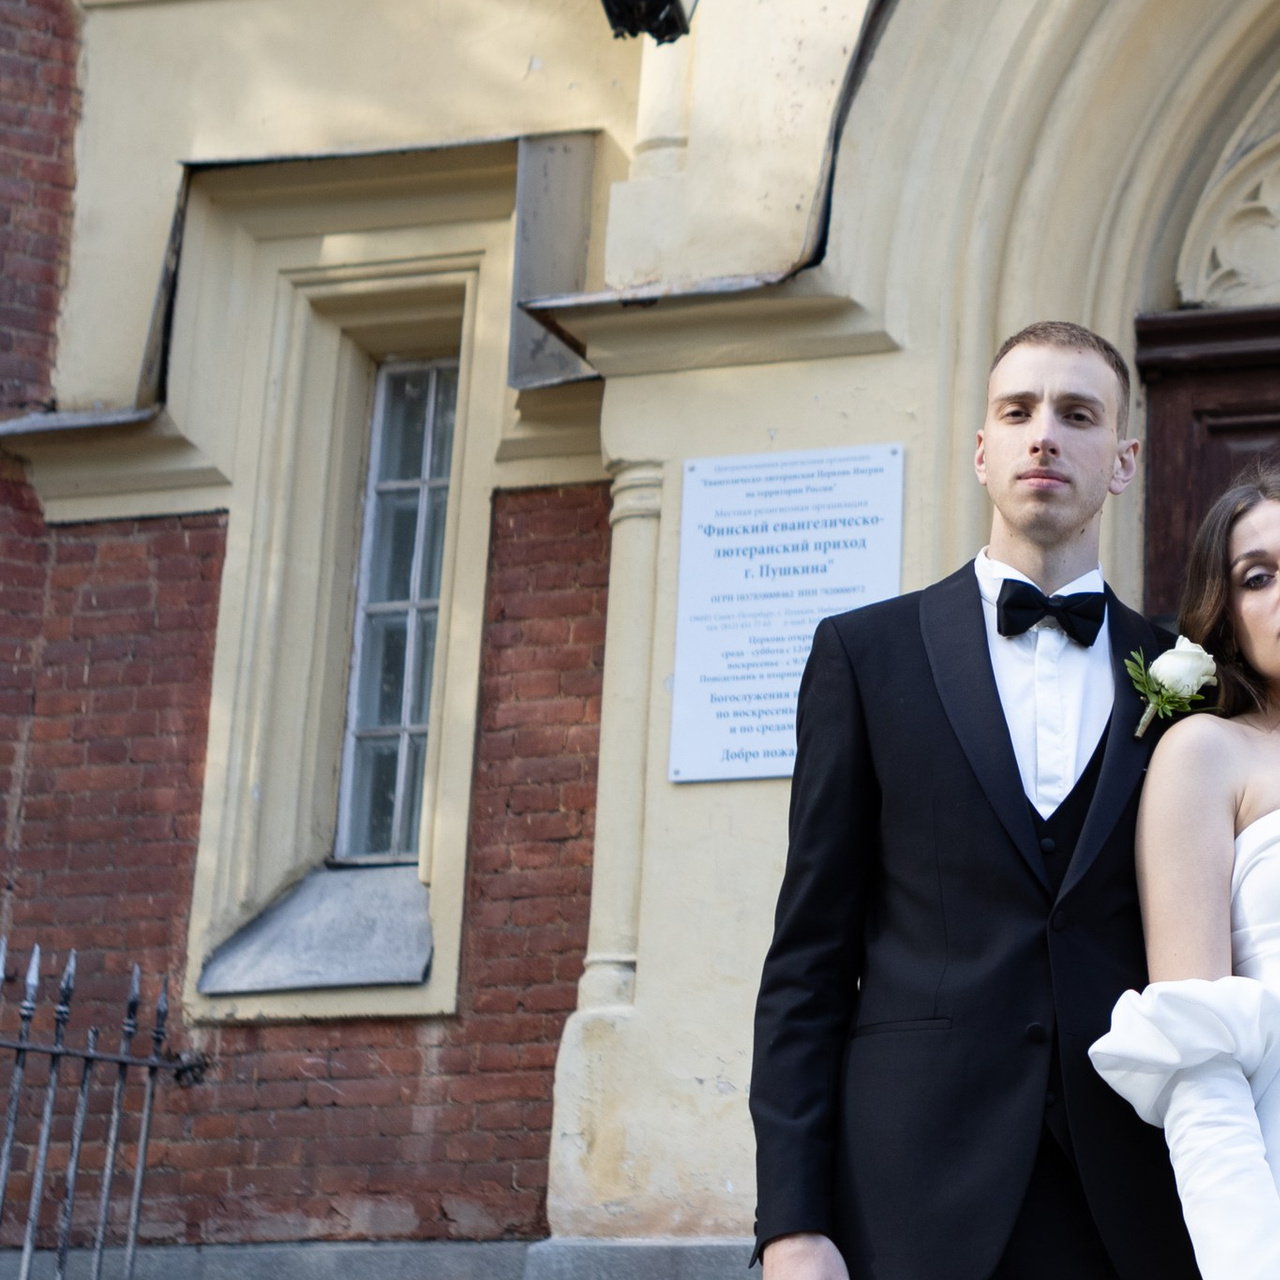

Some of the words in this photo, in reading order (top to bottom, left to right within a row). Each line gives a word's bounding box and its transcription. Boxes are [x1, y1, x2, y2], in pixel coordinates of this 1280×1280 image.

[715, 507, 752, 519] Местная
[754, 503, 809, 517] религиозная
[811, 500, 868, 513] организация
[698, 521, 769, 538] "Финский
[773, 515, 885, 533] евангелическо-
[714, 540, 809, 560] лютеранский
[814, 537, 867, 555] приход
[744, 567, 754, 579] г.
[759, 559, 834, 581] Пушкина"
[710, 594, 734, 604] ОГРН
[797, 589, 819, 598] ИНН
[749, 635, 786, 645] Церковь
[721, 650, 745, 660] среда
[751, 646, 784, 658] суббота
[727, 661, 779, 671] воскресенье
[700, 672, 757, 684] Понедельник
[710, 690, 790, 705] Богослужения
[716, 710, 729, 720] по
[730, 725, 737, 734] и
[740, 724, 753, 733] по
[756, 722, 794, 735] средам
[721, 747, 759, 763] Добро
